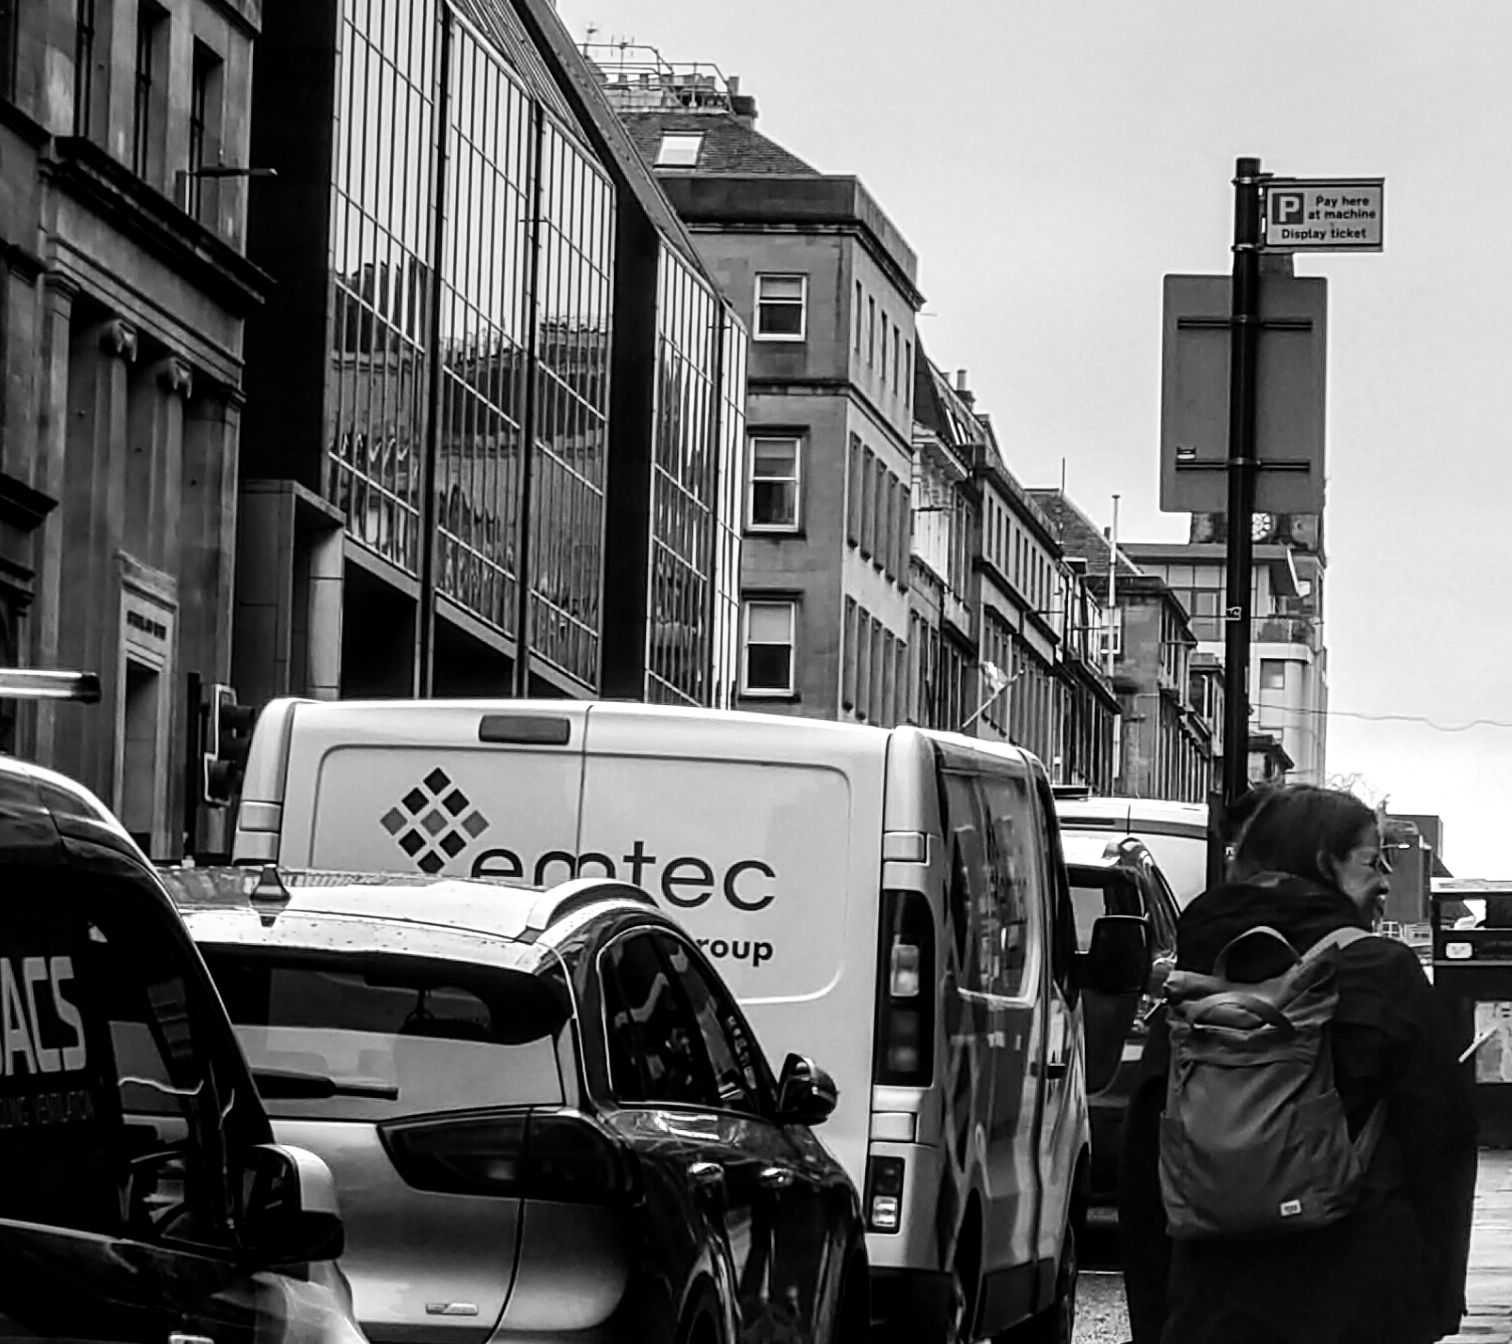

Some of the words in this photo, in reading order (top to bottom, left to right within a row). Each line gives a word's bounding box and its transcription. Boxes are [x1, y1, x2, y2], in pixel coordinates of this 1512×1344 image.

[1280, 196, 1300, 223] P
[1315, 196, 1338, 208] Pay
[1341, 196, 1370, 207] here
[1308, 210, 1321, 220] at
[1324, 209, 1377, 219] machine
[1281, 229, 1326, 240] Display
[1330, 228, 1367, 239] ticket
[470, 840, 776, 912] emtec
[0, 954, 88, 1078] ACS
